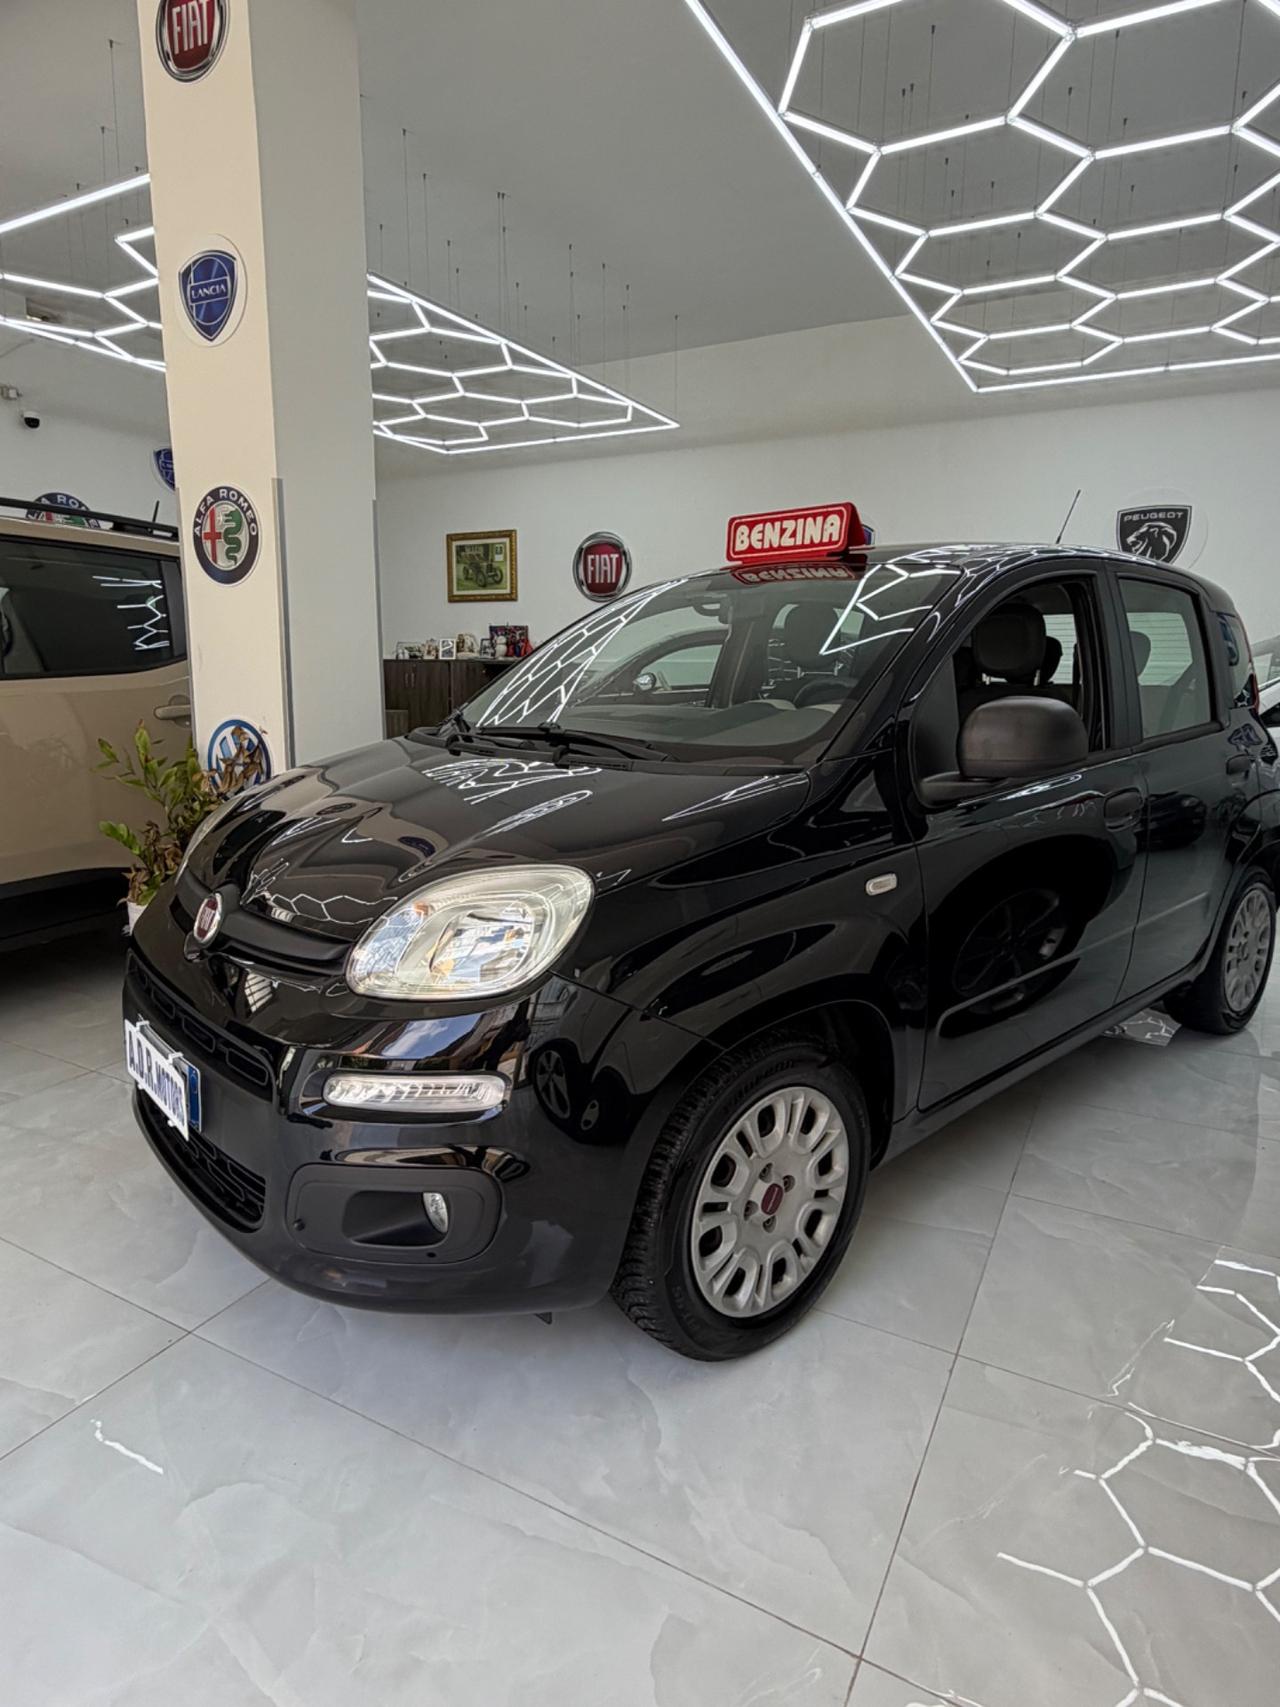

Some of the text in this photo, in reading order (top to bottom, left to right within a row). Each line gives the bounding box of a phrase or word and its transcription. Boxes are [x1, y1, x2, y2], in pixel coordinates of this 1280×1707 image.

[172, 0, 211, 55] FIAT
[191, 284, 227, 299] LANCIA
[194, 488, 258, 537] ALFA ROMEO
[1123, 511, 1184, 522] PEUGEOT
[735, 514, 841, 552] BENZINA
[587, 553, 620, 584] FIAT
